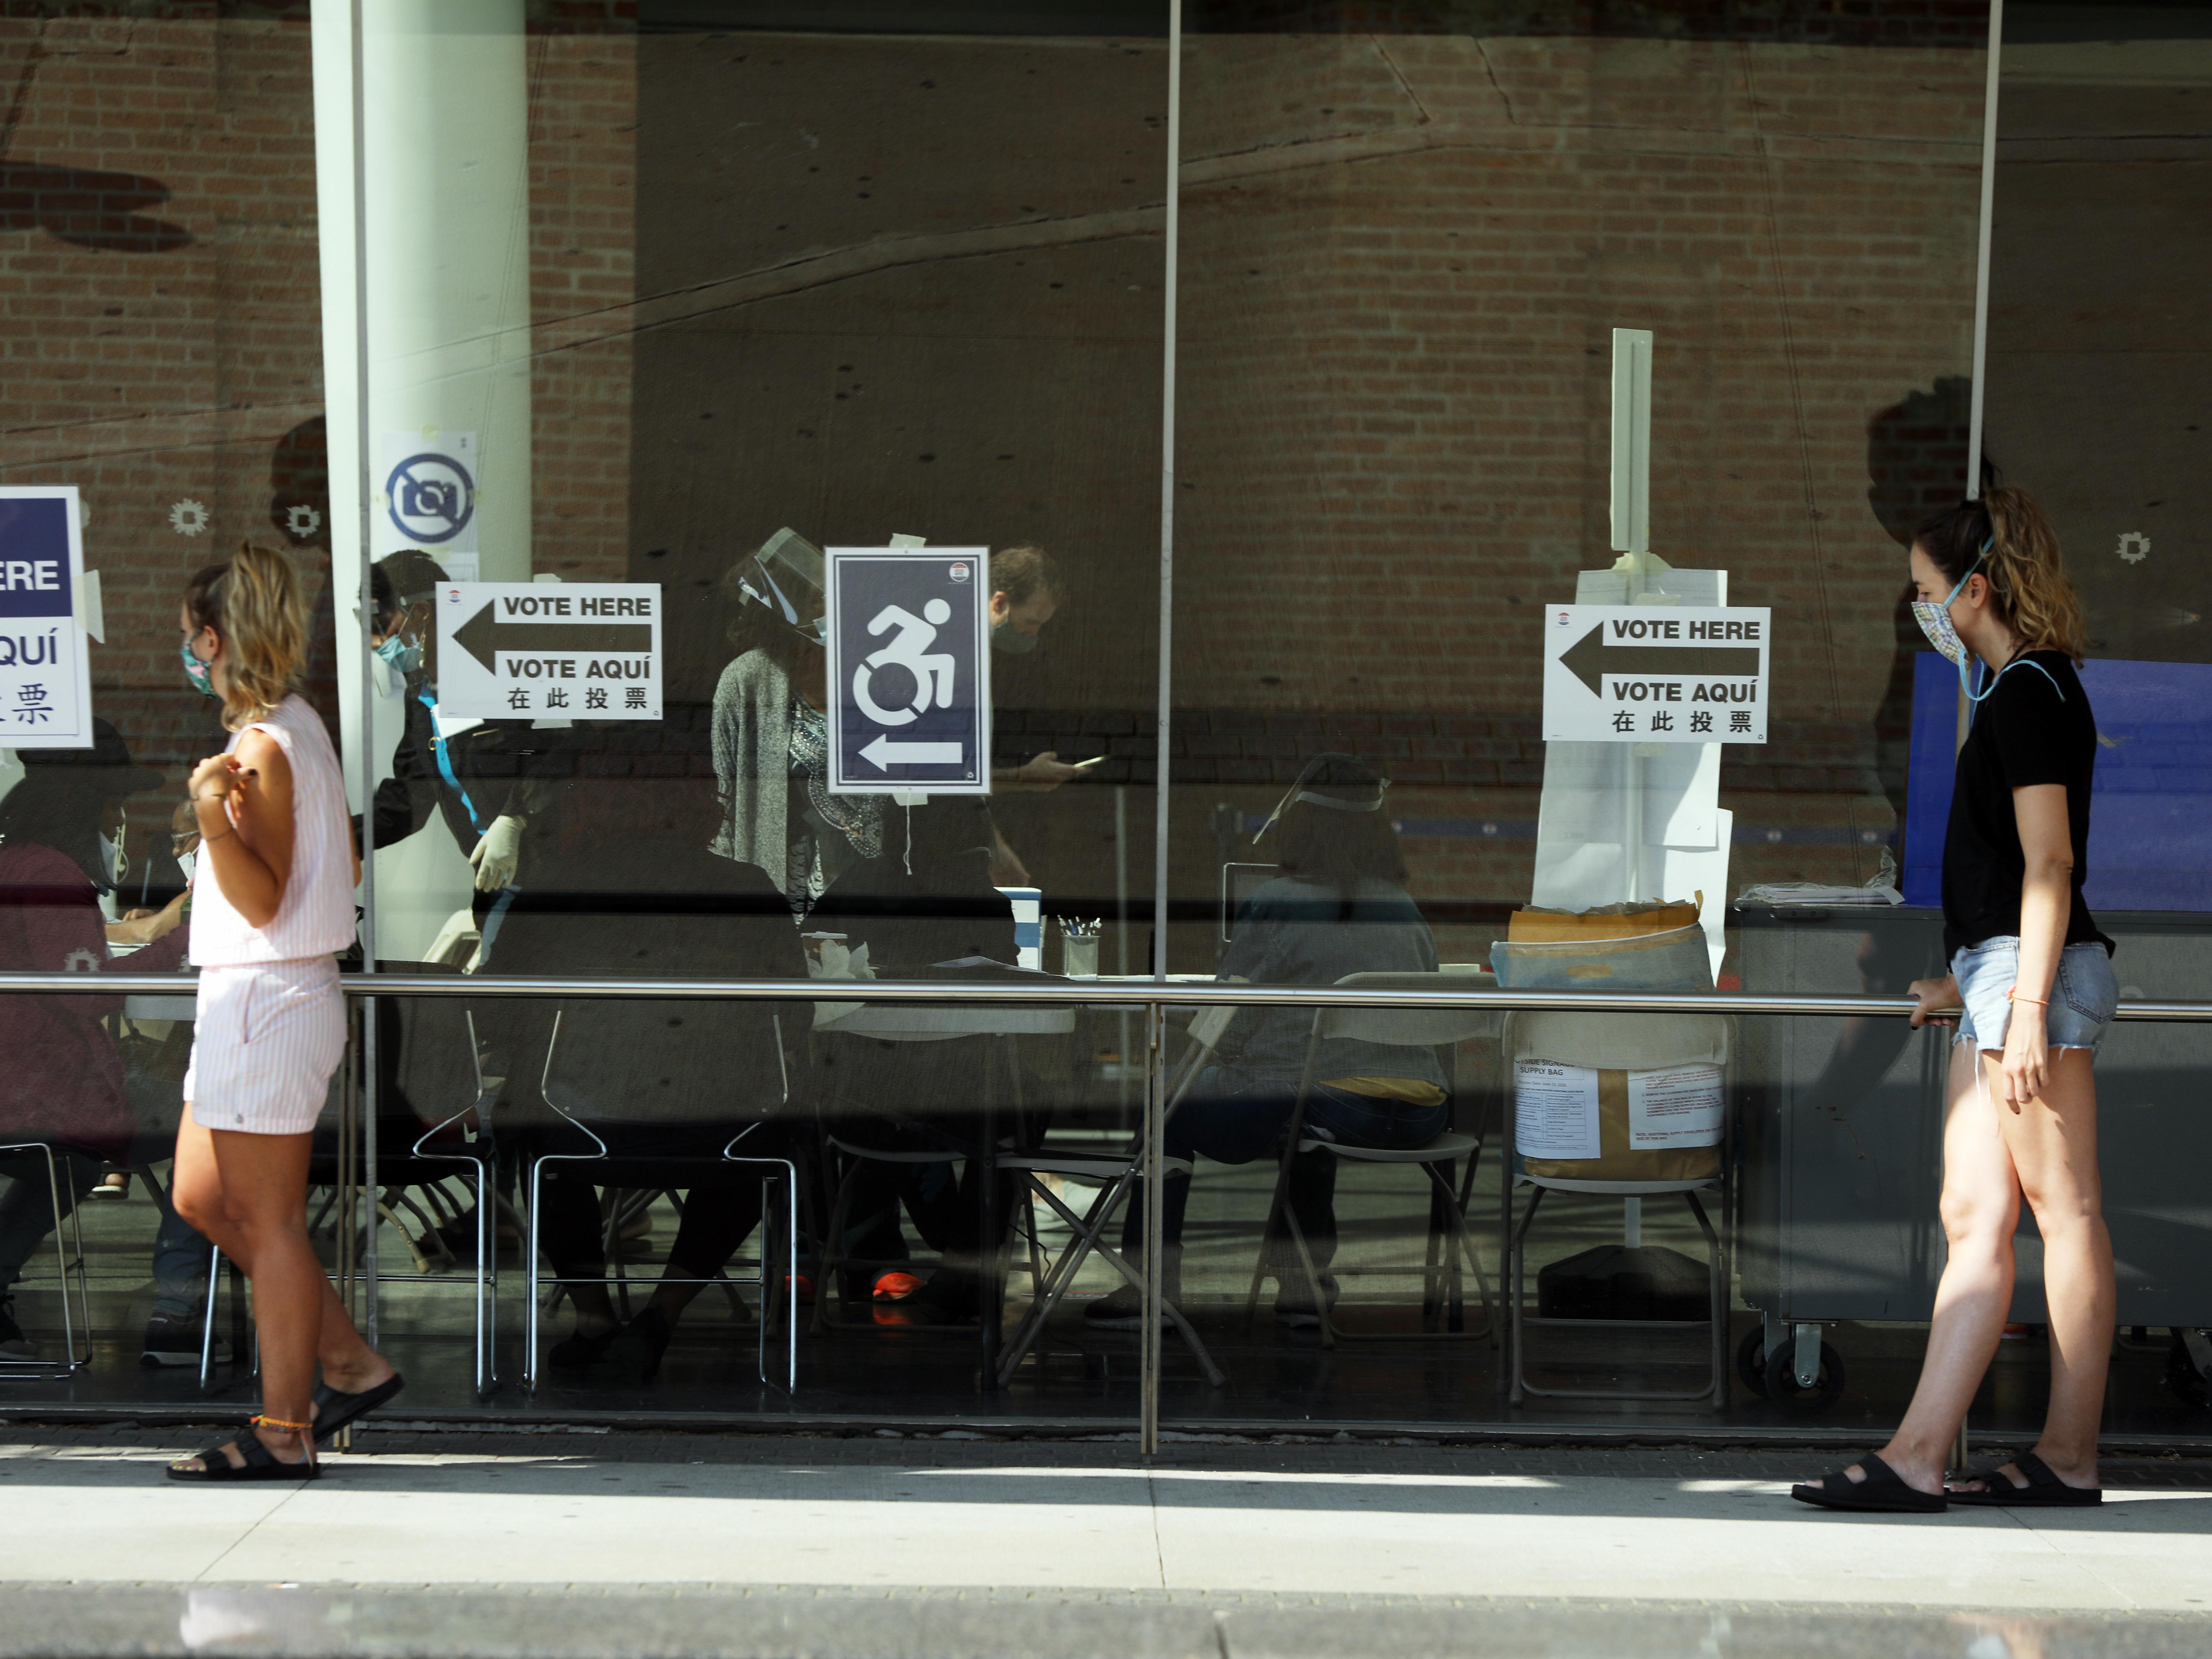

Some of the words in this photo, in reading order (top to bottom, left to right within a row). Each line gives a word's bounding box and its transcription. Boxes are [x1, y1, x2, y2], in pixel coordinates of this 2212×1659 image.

[0, 560, 60, 591] RE
[504, 597, 571, 616] VOTE
[581, 597, 651, 616] HERE
[1613, 620, 1680, 639] VOTE
[1689, 621, 1760, 640] HERE
[507, 659, 576, 678] VOTE
[586, 655, 652, 680] AQUÍ
[507, 687, 647, 710] 在此投票
[1613, 682, 1682, 701] VOTE
[1691, 679, 1759, 703] AQUÍ
[0, 683, 53, 725] 票
[1612, 710, 1752, 733] 在此投票
